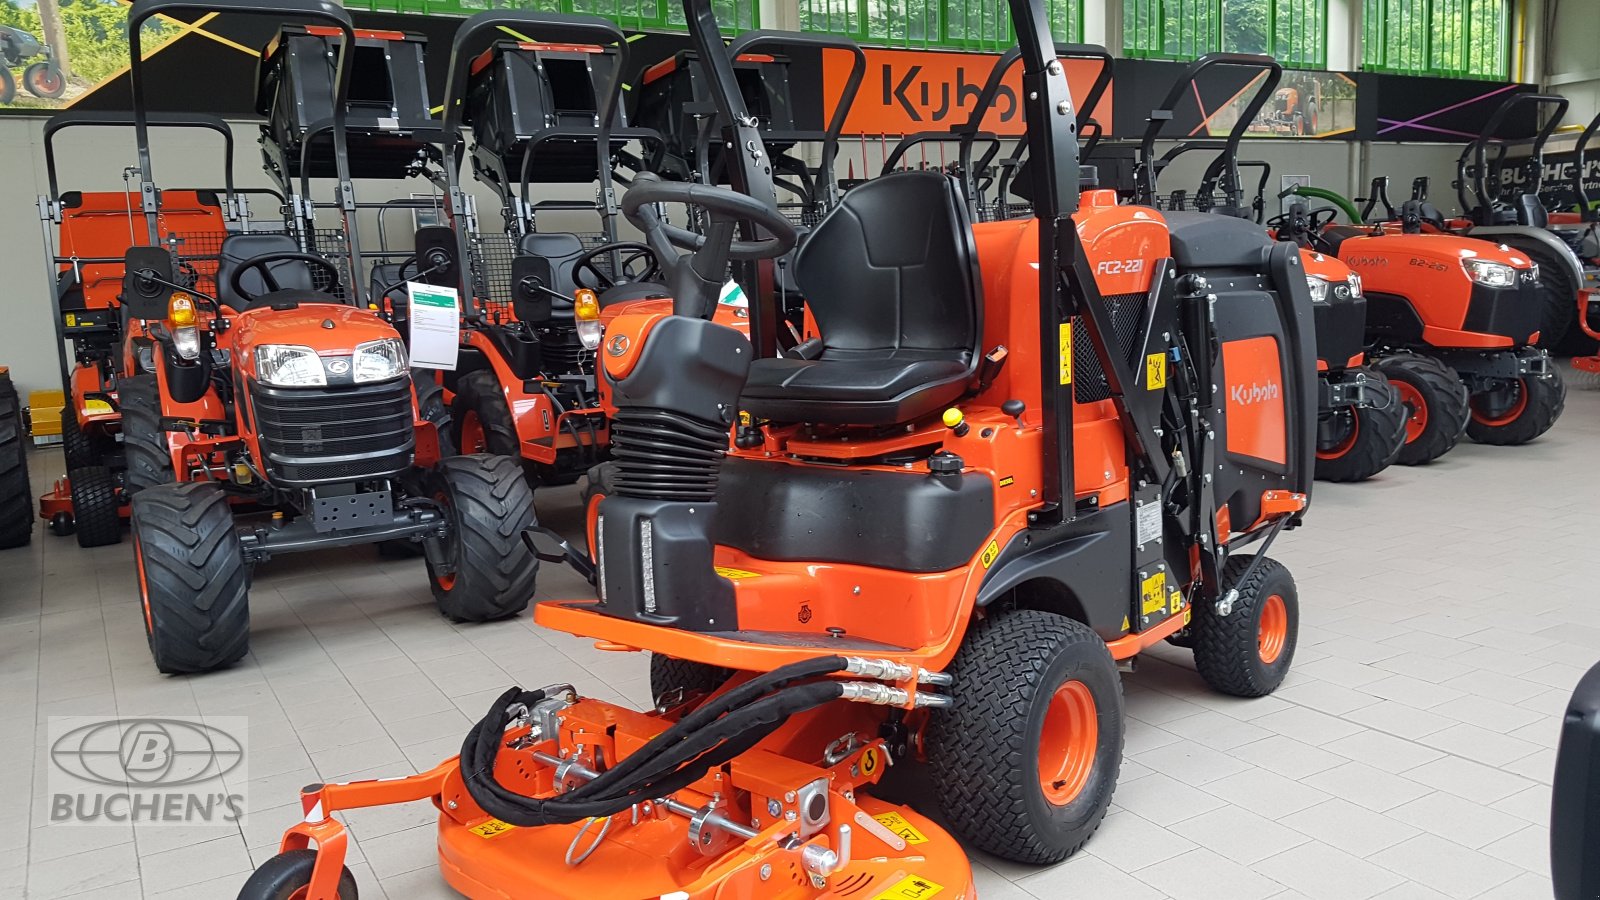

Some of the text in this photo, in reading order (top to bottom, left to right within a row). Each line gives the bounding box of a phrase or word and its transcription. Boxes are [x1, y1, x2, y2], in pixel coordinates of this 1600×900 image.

[1097, 259, 1143, 275] FC2-221
[1346, 255, 1449, 272] Kubota B2-261
[1231, 379, 1278, 405] Kubota
